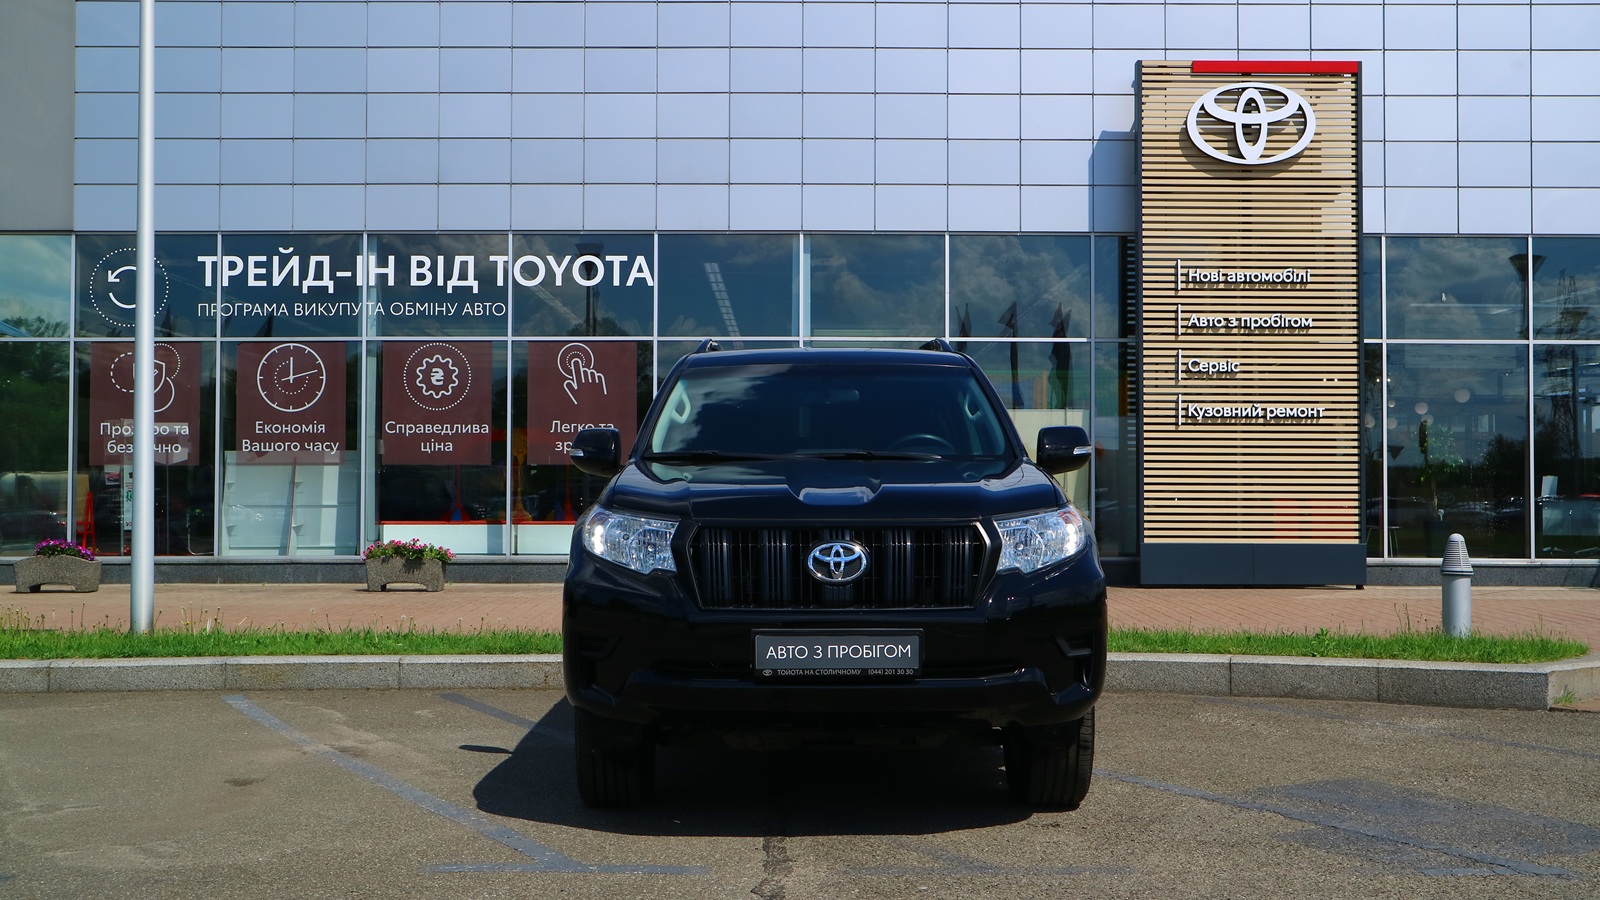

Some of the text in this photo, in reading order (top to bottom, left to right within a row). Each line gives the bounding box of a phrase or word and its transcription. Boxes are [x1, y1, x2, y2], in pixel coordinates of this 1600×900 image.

[197, 247, 654, 294] ТРЕЙД-ІН ВІД TOYOTA
[1188, 269, 1311, 282] Нові автомобілі
[198, 302, 506, 317] ПРОГРАМА ВИКУПУ ТА ОБМІНУ АВТО
[1188, 313, 1313, 330] Авто з пробігом
[1188, 359, 1240, 374] Сервіс
[1188, 403, 1325, 420] Кузовний ремонт
[173, 425, 189, 435] та
[255, 421, 326, 434] Економія
[385, 421, 489, 436] Справедлива
[107, 440, 181, 453] безчно
[242, 439, 339, 454] Вашого часу
[420, 441, 453, 453] ціна
[766, 644, 911, 659] АВТО З ПРОБІГОМ
[815, 668, 862, 676] СТОЛИЧНОМУ
